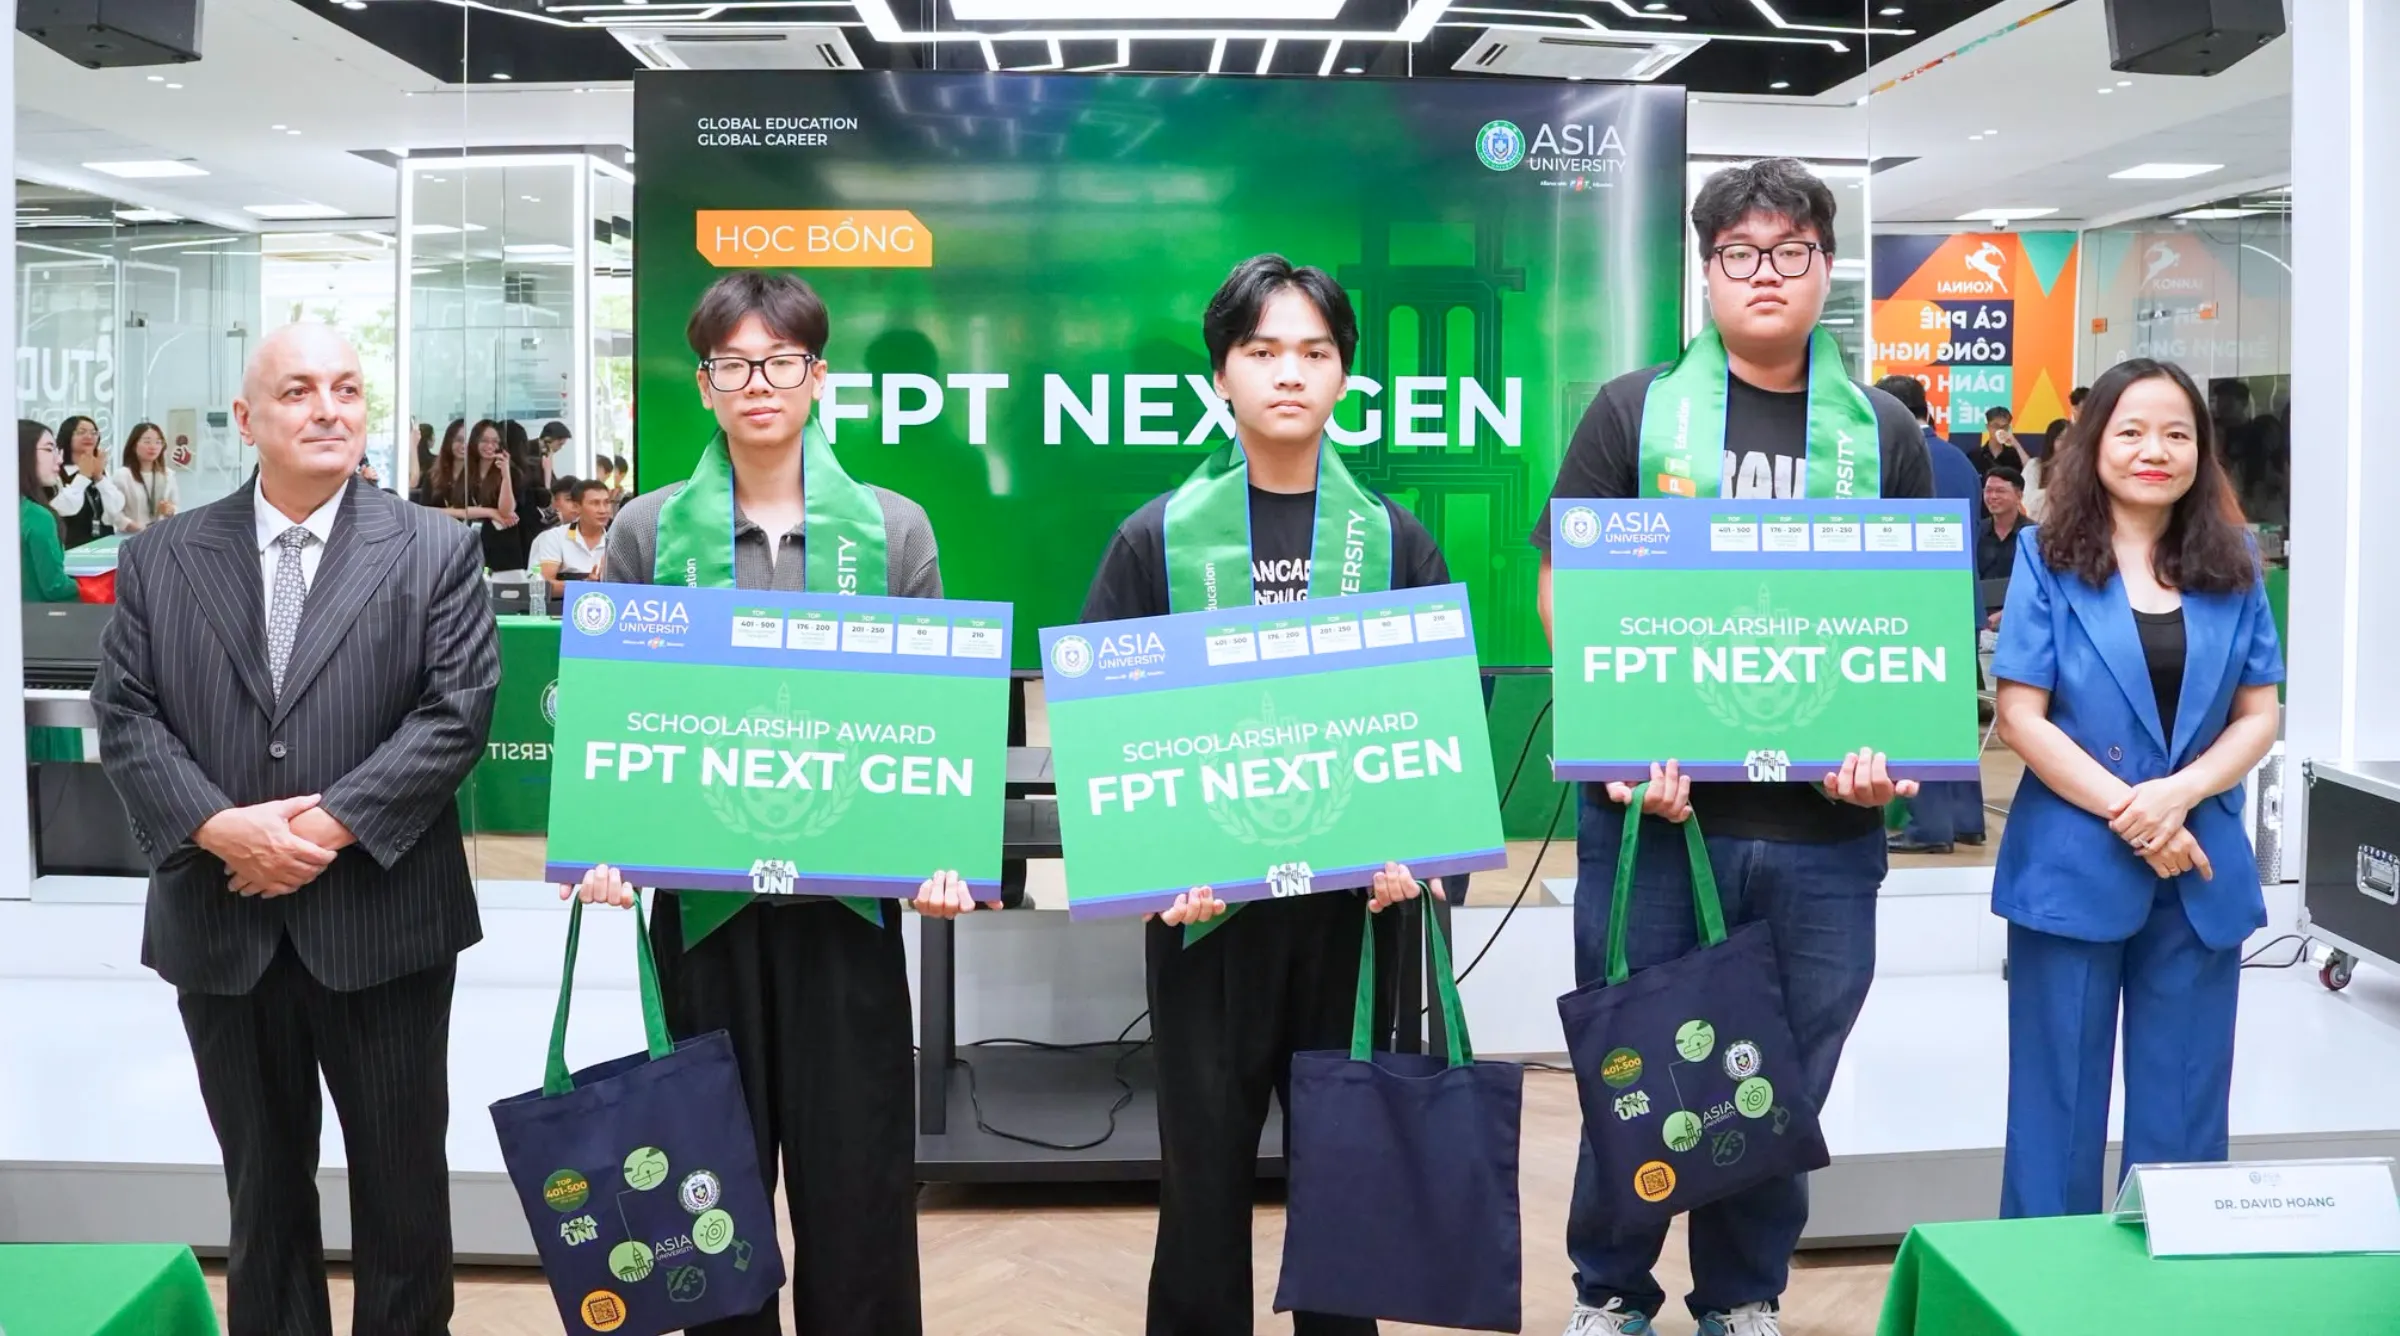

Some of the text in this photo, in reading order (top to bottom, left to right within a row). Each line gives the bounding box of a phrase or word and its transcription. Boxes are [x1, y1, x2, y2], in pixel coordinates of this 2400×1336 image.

[698, 117, 858, 130] GLOBAL EDUCATION
[698, 133, 827, 146] GLOBAL CAREER
[1530, 123, 1627, 156] ASIA
[1530, 157, 1626, 172] UNIVERSITY
[716, 216, 914, 259] HỌC BỔNG
[818, 373, 1522, 446] FPT NEX GEN
[1836, 428, 1855, 499] RSITY
[1605, 511, 1671, 533] ASIA
[1605, 533, 1670, 543] UNIVERSITY
[1340, 509, 1366, 597] ERSITY
[685, 557, 697, 588] ation
[621, 599, 690, 623] ASIA
[619, 622, 689, 634] UNIVERSITY
[760, 621, 775, 629] 500
[816, 623, 830, 631] 200
[1620, 617, 1908, 636] SCHOOLARSHIP AWARD
[1099, 631, 1165, 658] ASIA
[1099, 653, 1166, 669] UNIVERSITY
[1584, 646, 1947, 684] FPT NEXT GEN
[627, 712, 936, 745] SCHOOLARSHIP AWARD
[1122, 711, 1419, 762] SCHOOLARSHIP AWARD
[584, 741, 973, 797] FPT NEXT GEN
[1088, 736, 1463, 816] FPT NEXT GEN
[1747, 765, 1787, 782] UNI
[753, 876, 794, 894] UNI
[1271, 877, 1311, 897] UNI
[1603, 1057, 1642, 1076] 401-500
[1613, 1054, 1627, 1063] TOP
[1618, 1101, 1650, 1121] UNI
[1703, 1101, 1735, 1123] ASIA
[1704, 1111, 1736, 1129] UNIVERSITY
[546, 1180, 588, 1198] 401-500
[556, 1178, 572, 1187] TOP
[2214, 1197, 2335, 1210] DR. DAVID HOANG
[564, 1226, 599, 1246] UNI
[654, 1234, 692, 1255] ASIA
[656, 1245, 694, 1261] UNIVERSITY
